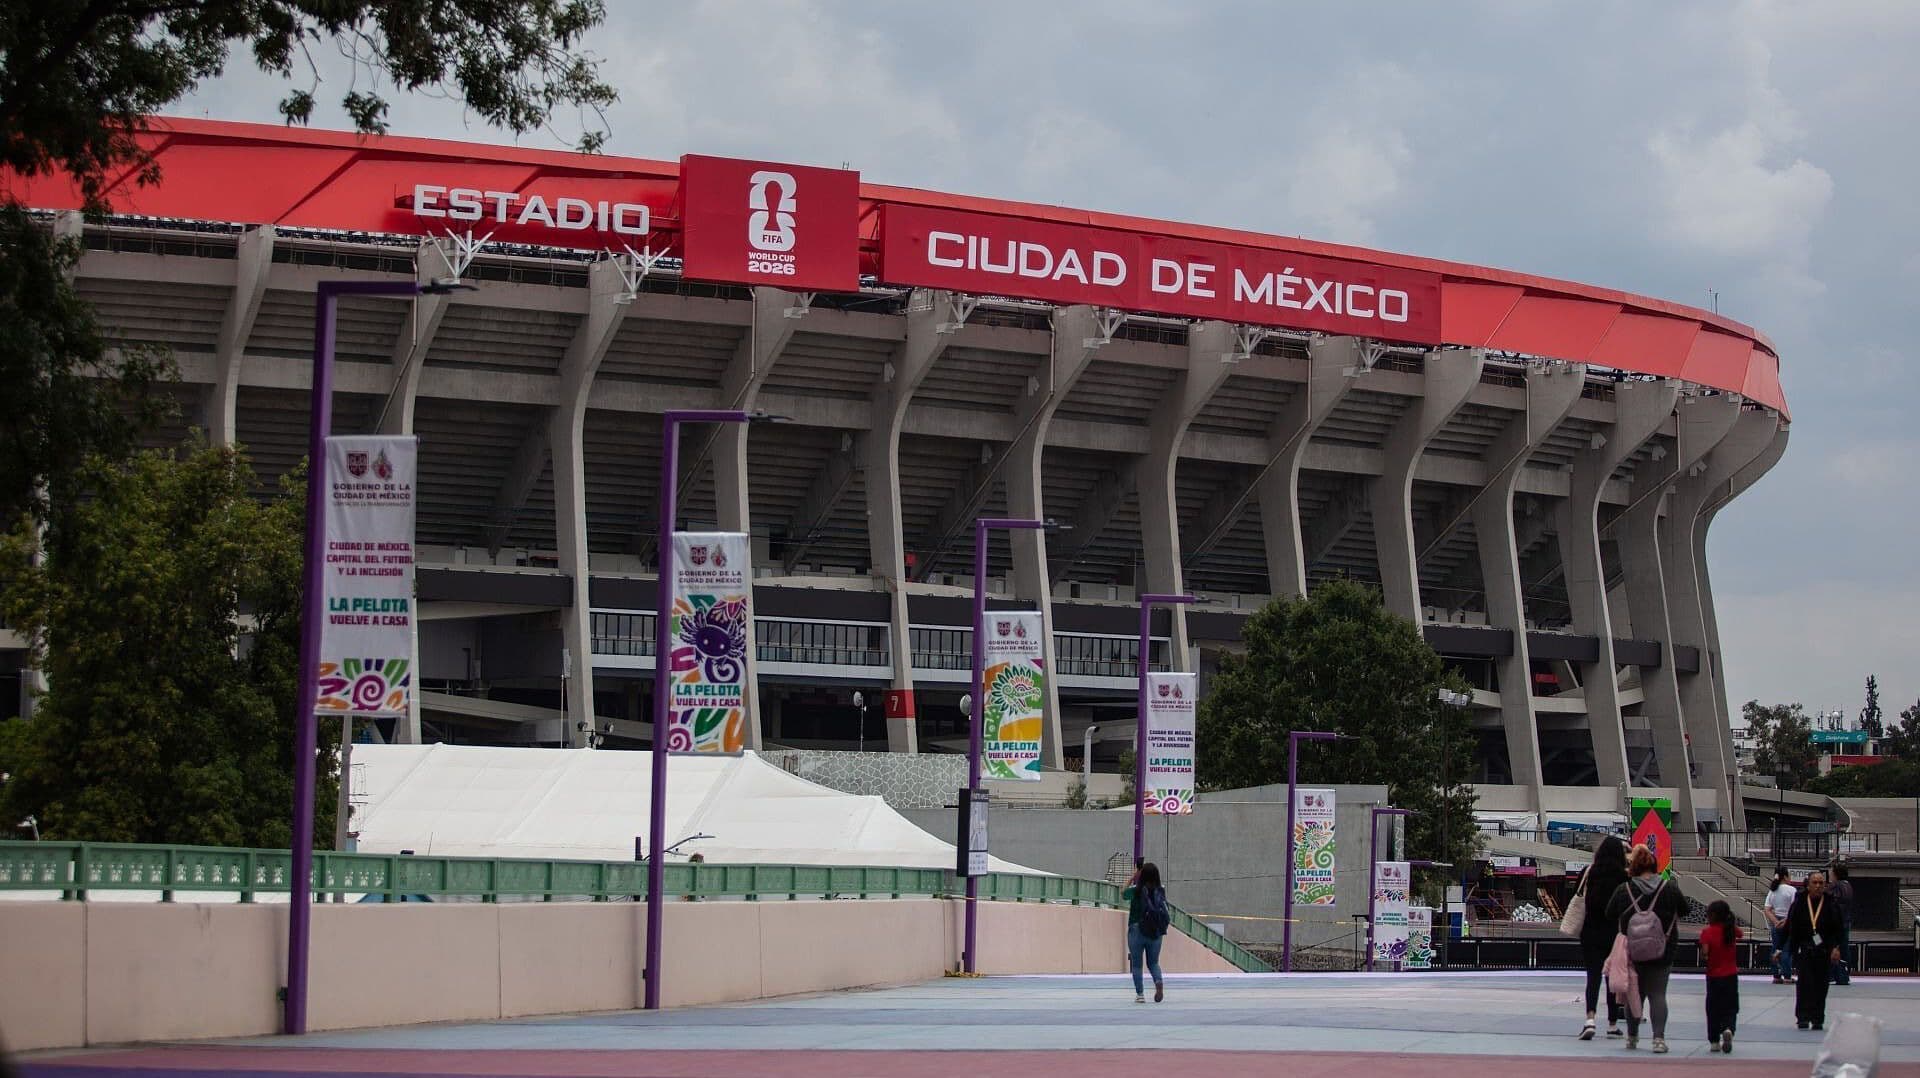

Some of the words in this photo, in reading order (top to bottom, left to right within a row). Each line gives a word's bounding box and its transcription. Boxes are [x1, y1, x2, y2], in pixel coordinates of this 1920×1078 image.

[414, 184, 649, 235] ESTADIO
[762, 234, 783, 244] FIFA
[748, 252, 778, 260] WORLD
[779, 254, 796, 262] CUP
[748, 260, 796, 275] 2026
[928, 230, 1127, 287] CIUDAD
[1152, 258, 1216, 298] DE
[1234, 267, 1408, 322] MÉXICO
[330, 542, 362, 550] CIUDAD
[365, 542, 376, 551] DE
[327, 554, 362, 563] CAPITAL
[365, 555, 380, 563] DEL
[339, 568, 344, 576] Y
[347, 568, 357, 576] LA
[360, 567, 403, 576] INCLUSIÓN
[330, 597, 348, 612] LA
[353, 598, 408, 612] PELOTA
[330, 615, 369, 625] VUELVE
[372, 615, 379, 625] A
[382, 616, 408, 626] CASA
[676, 685, 691, 695] LA
[695, 685, 741, 696] PELOTA
[891, 696, 898, 711] 7
